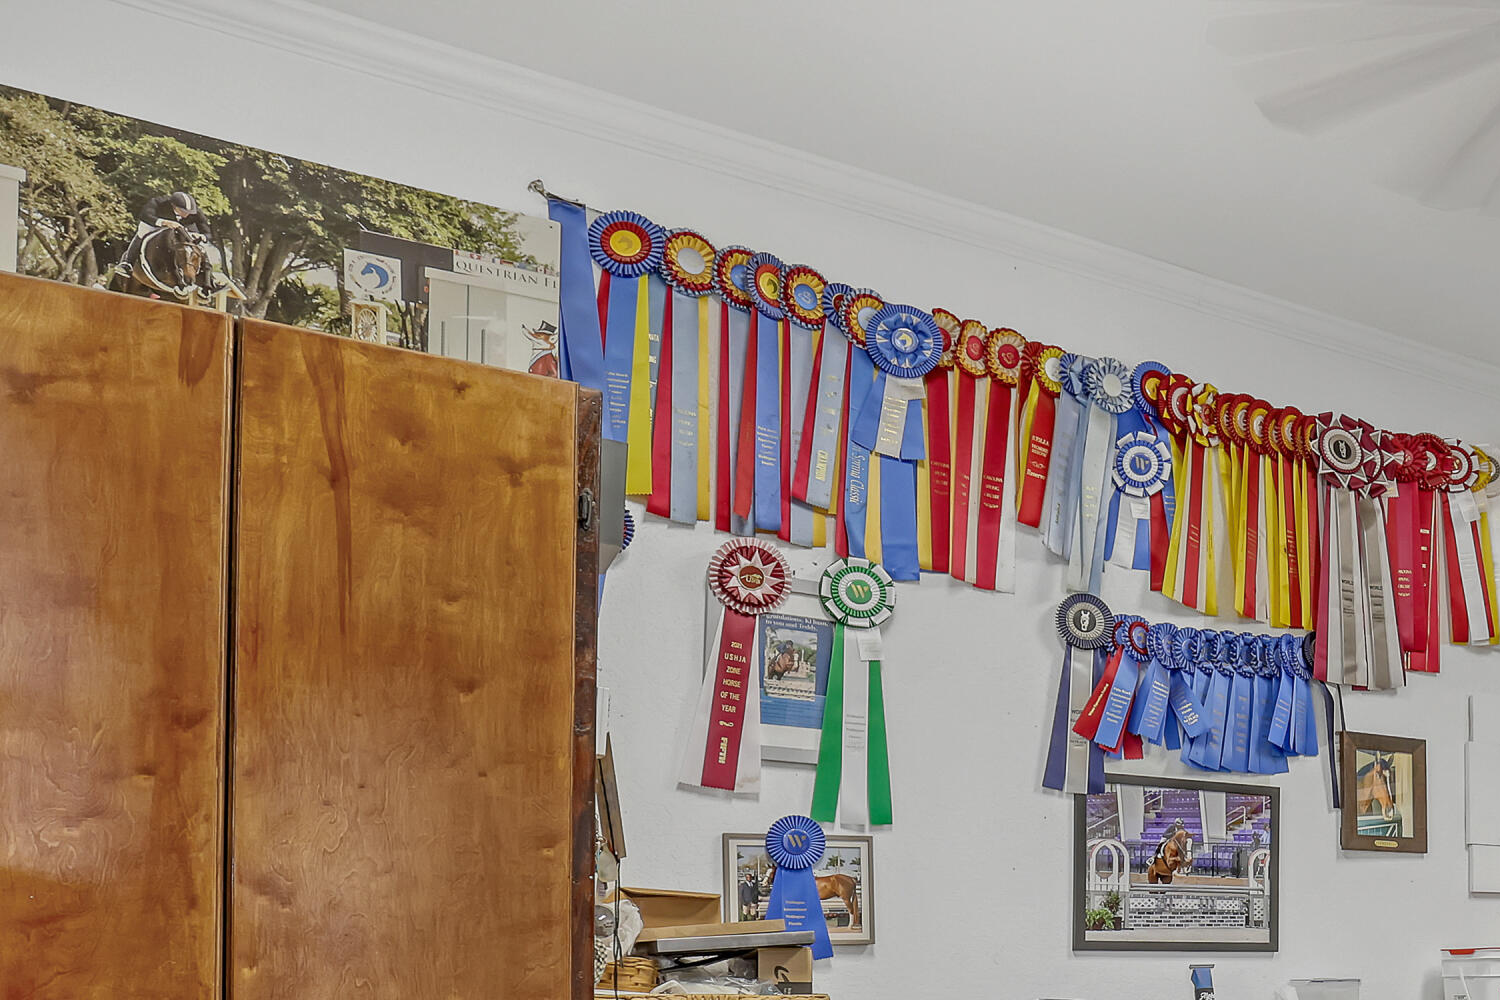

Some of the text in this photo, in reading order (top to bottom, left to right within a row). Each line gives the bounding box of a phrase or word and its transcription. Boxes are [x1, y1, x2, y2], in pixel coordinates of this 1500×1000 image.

[724, 653, 746, 664] USHJA
[726, 666, 741, 675] ZONE
[722, 678, 741, 688] HORSE
[720, 691, 740, 701] OF THE
[721, 704, 736, 713] YEAR
[718, 736, 728, 764] FIFTH
